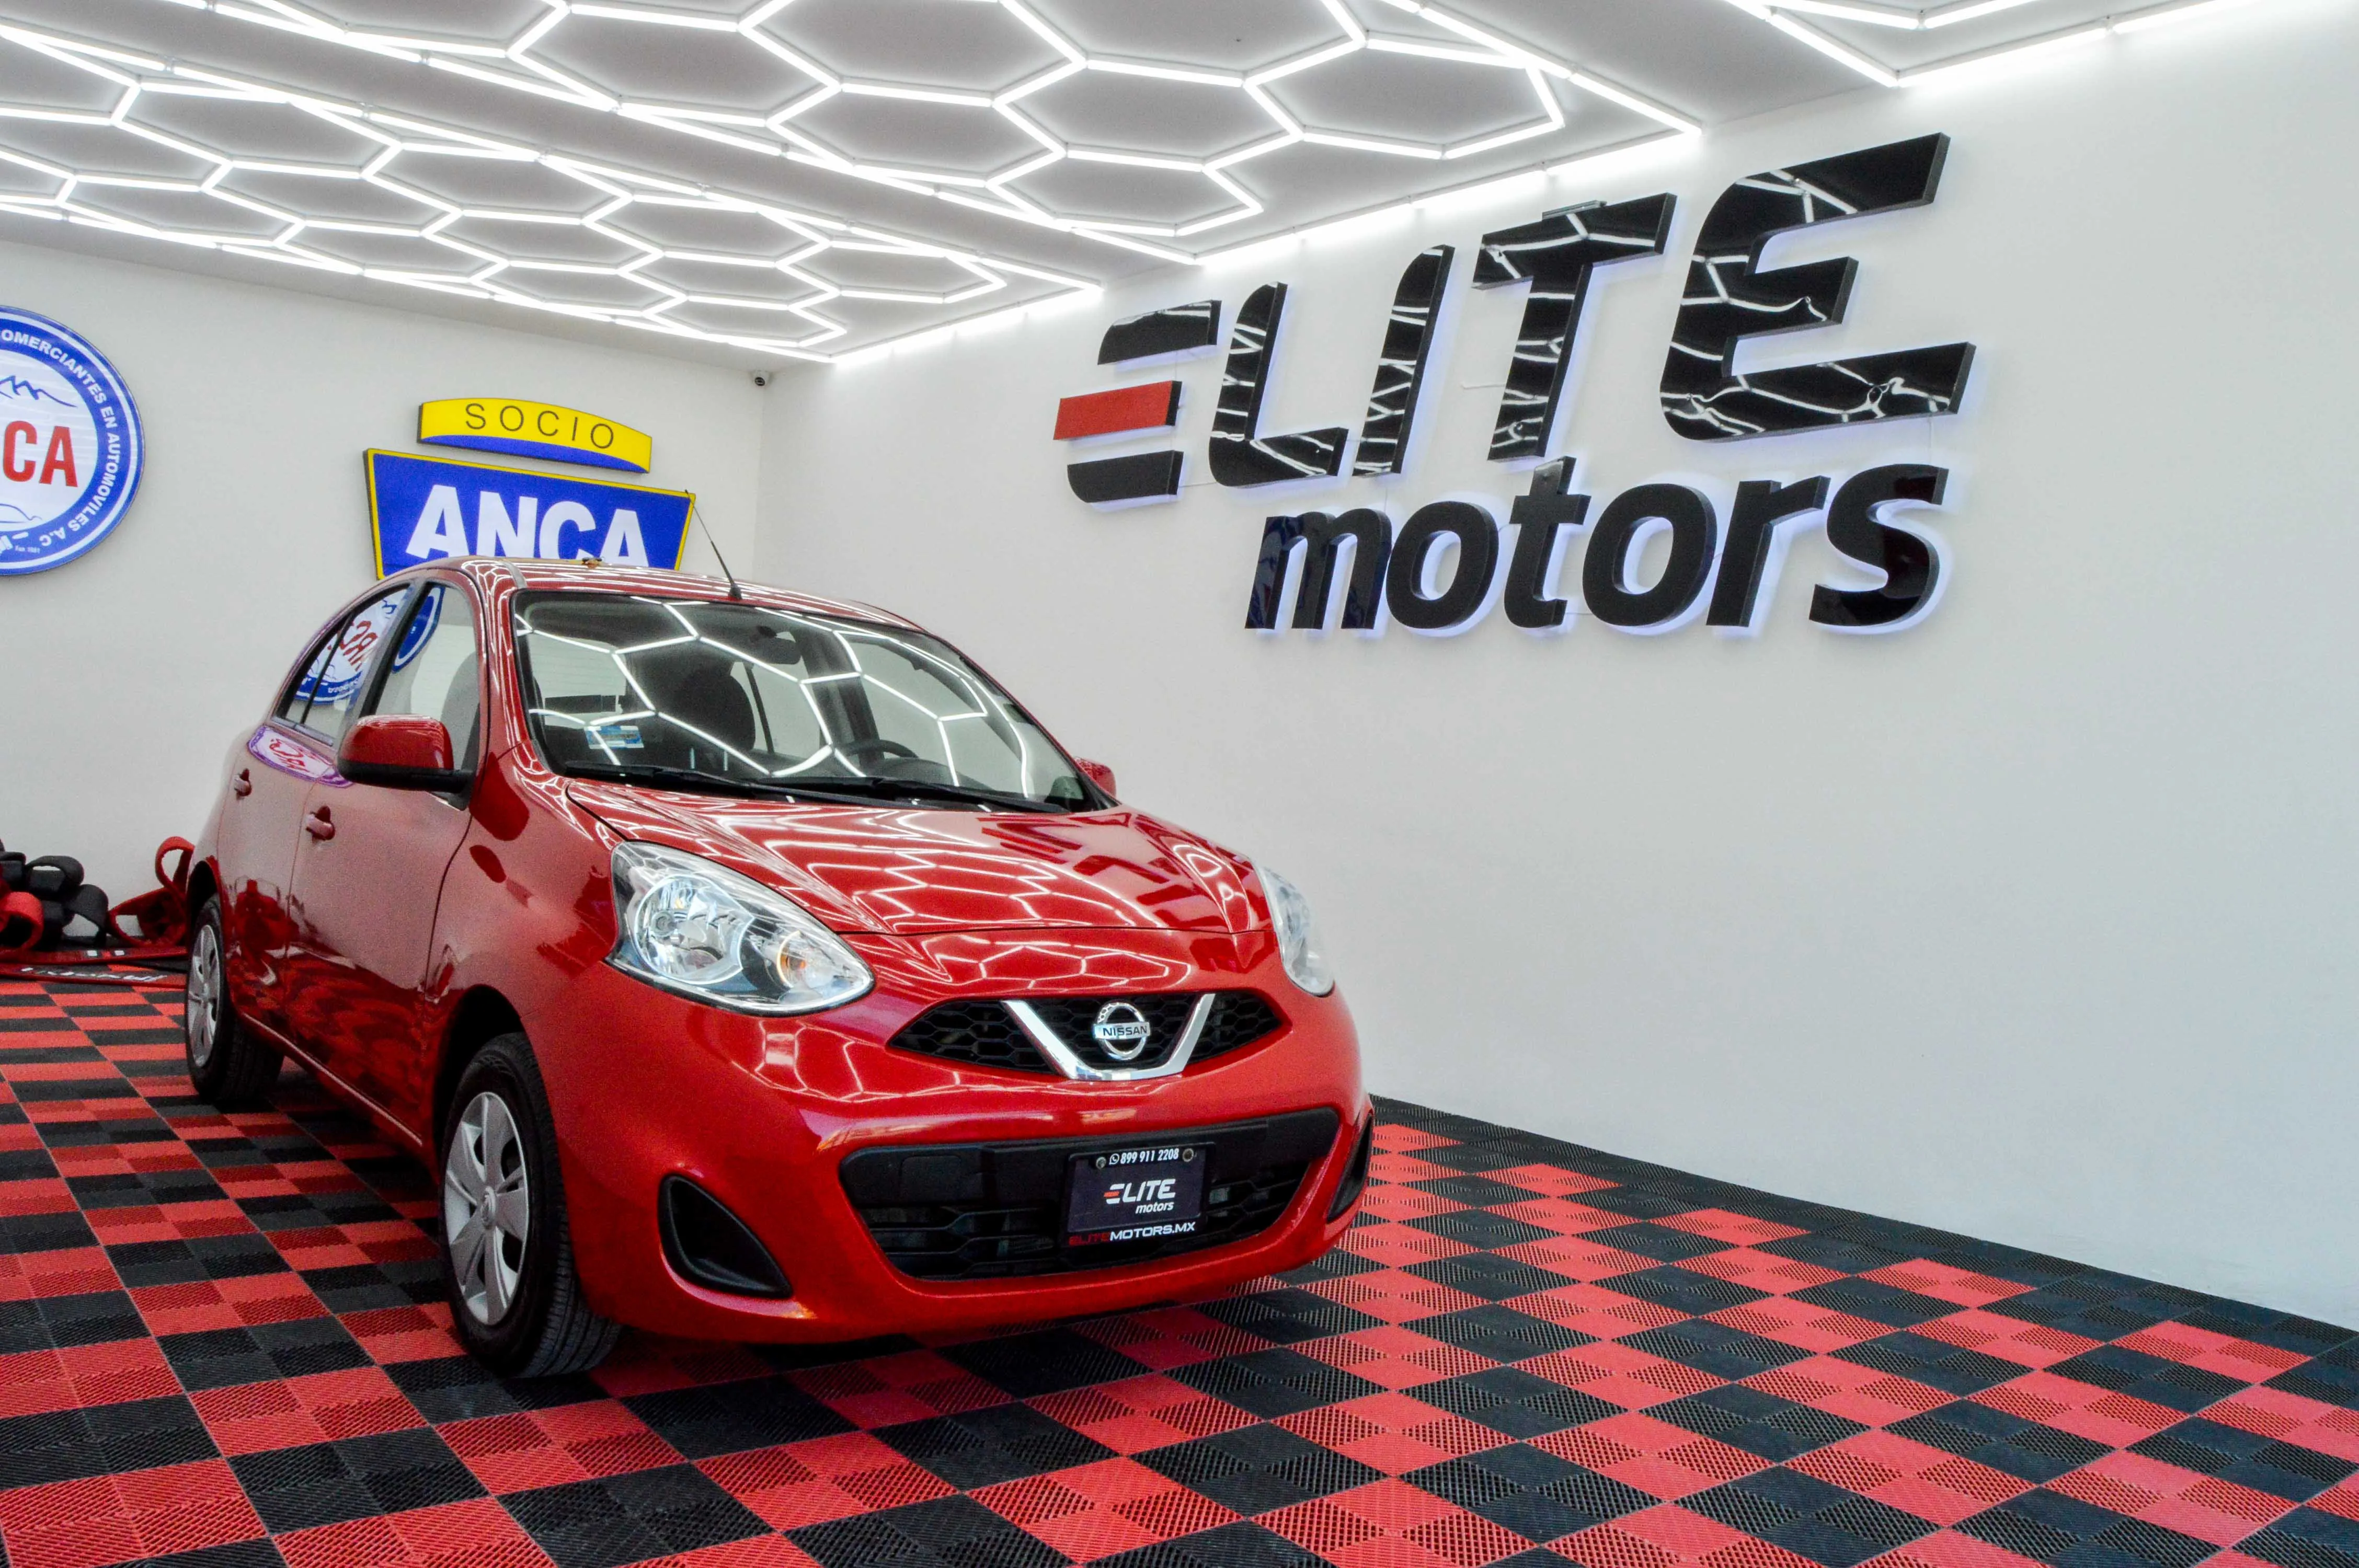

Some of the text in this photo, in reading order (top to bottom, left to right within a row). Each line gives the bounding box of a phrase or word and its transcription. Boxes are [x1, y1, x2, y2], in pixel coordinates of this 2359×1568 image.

[1052, 132, 1976, 503] ELITE
[0, 329, 107, 403] OMERCIANTES
[100, 406, 118, 429] EN
[465, 402, 614, 449] SOCIO
[67, 432, 121, 532] AUTOMOVILES
[405, 484, 649, 568] ANCA
[1244, 456, 1950, 631] motors
[1103, 1025, 1147, 1036] NISSAN
[1120, 1148, 1180, 1165] 899 911 2208
[1104, 1179, 1176, 1205] ELITE
[1135, 1202, 1175, 1214] motors
